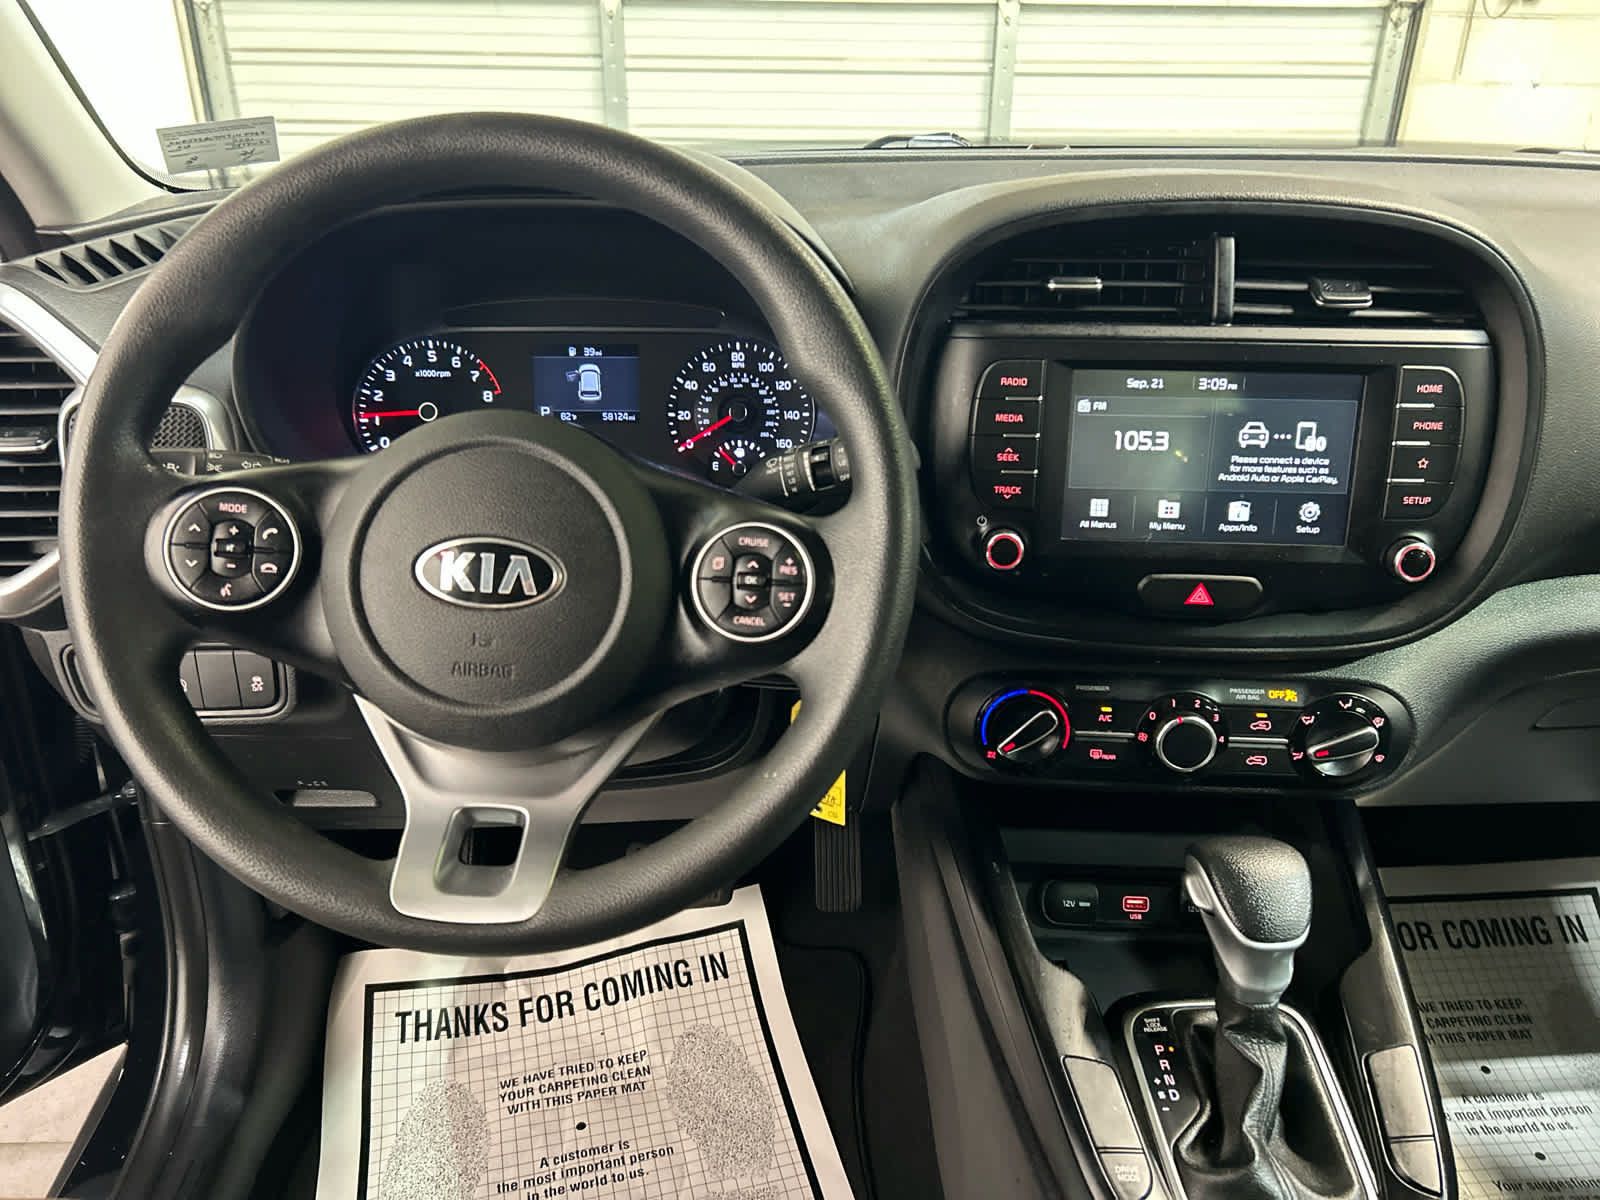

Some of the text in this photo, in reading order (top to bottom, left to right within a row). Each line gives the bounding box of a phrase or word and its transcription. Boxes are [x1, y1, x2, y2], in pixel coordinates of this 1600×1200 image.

[403, 355, 413, 367] 4
[427, 351, 437, 362] 5
[731, 352, 745, 362] 80
[452, 357, 461, 368] 6
[702, 363, 716, 372] 60
[758, 362, 775, 372] 100
[385, 370, 396, 382] 3
[415, 370, 451, 379] x1000rpm
[470, 371, 480, 382] 7
[684, 381, 698, 391] 40
[775, 381, 792, 391] 120
[1000, 377, 1028, 387] RADIO
[1126, 377, 1164, 389] Sep. 21
[1416, 384, 1444, 394] HOME
[373, 390, 383, 401] 2
[483, 391, 493, 402] 8
[540, 406, 551, 416] P
[1093, 401, 1107, 411] FM
[677, 410, 692, 421] 20
[784, 410, 801, 421] 140
[995, 413, 1024, 423] MEDIA
[1413, 421, 1444, 431] PHONE
[380, 437, 390, 448] 0
[776, 439, 793, 449] 160
[1114, 430, 1170, 451] 105.3
[996, 453, 1019, 462] SEEK
[1231, 455, 1258, 464] Please
[1259, 456, 1292, 464] connect
[1301, 457, 1330, 465] device
[712, 461, 719, 471] E
[1264, 465, 1297, 473] features
[1218, 473, 1250, 481] Android
[1251, 474, 1270, 482] Auto
[1280, 475, 1304, 483] Apple
[994, 486, 1022, 495] TRACK
[1403, 496, 1432, 505] SETUP
[218, 502, 248, 514] MODE
[1079, 520, 1117, 529] All Menus
[1149, 522, 1186, 531] My Menu
[1296, 525, 1320, 534] Setup
[738, 537, 769, 548] CRUISE
[439, 550, 538, 596] KIA
[744, 575, 758, 585] OK
[778, 591, 797, 601] SET
[733, 615, 766, 627] CANCEL
[1268, 690, 1285, 699] OFF
[1171, 699, 1177, 707] 1
[1194, 700, 1200, 709] 2
[1149, 711, 1156, 720] 0
[1213, 714, 1219, 722] 3
[1218, 735, 1225, 743] 4
[1062, 899, 1075, 908] 12V
[1396, 914, 1590, 952] OR COMING IN
[395, 951, 729, 1044] THANKS FOR COMING IN
[1476, 998, 1493, 1010] TO
[1494, 997, 1523, 1010] KEEP
[1426, 1012, 1534, 1030] CARPETING CLEAN
[1467, 1030, 1507, 1042] PAPER
[1154, 1044, 1165, 1056] P
[500, 1050, 648, 1090] WE HAVE TRIED TO KEEP
[1159, 1059, 1170, 1071] R
[499, 1065, 651, 1103] YOUR CARPETING CLEAN
[1163, 1074, 1175, 1086] N
[507, 1080, 647, 1115] WITH THIS PAPER MAT
[1168, 1088, 1180, 1101] D
[1462, 1089, 1545, 1105] A customer is
[1454, 1108, 1488, 1122] most
[1488, 1104, 1549, 1121] important
[1549, 1103, 1593, 1118] person
[1464, 1124, 1480, 1136] in
[1481, 1123, 1503, 1136] the
[1503, 1121, 1540, 1135] world
[1540, 1121, 1556, 1132] to
[539, 1139, 631, 1169] A customer is
[497, 1145, 674, 1194] the most important person
[527, 1166, 650, 1200] in the world to us.
